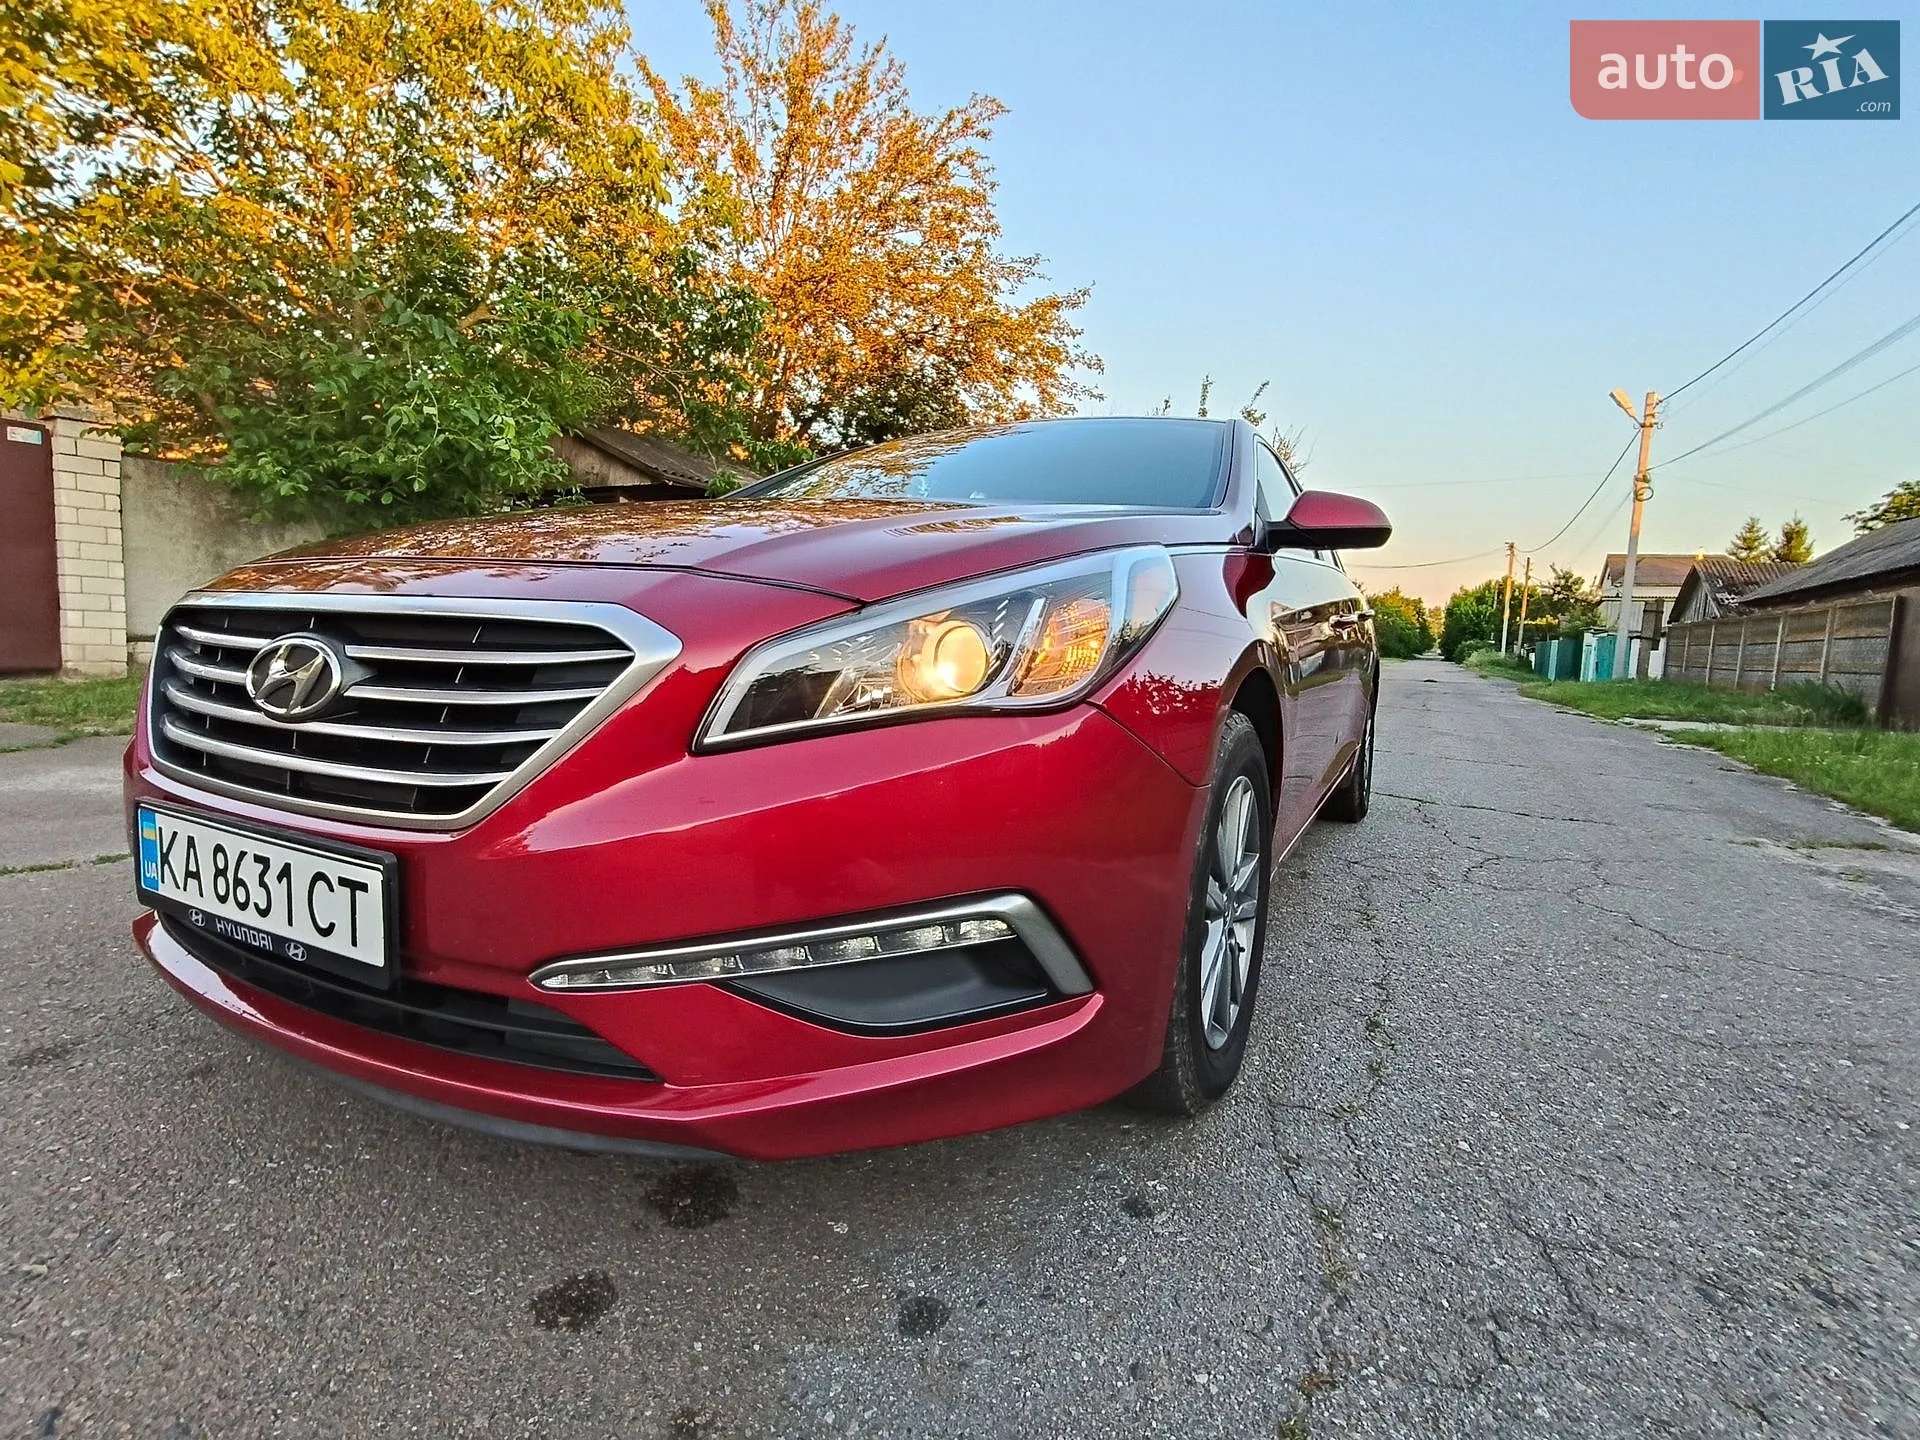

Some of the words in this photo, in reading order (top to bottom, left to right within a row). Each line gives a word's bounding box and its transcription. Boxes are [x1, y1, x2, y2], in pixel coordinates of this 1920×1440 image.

[144, 860, 158, 880] UA
[158, 826, 204, 898] KA
[212, 843, 294, 928] 8631
[307, 870, 369, 948] CT
[216, 918, 273, 951] HYUNDAI
